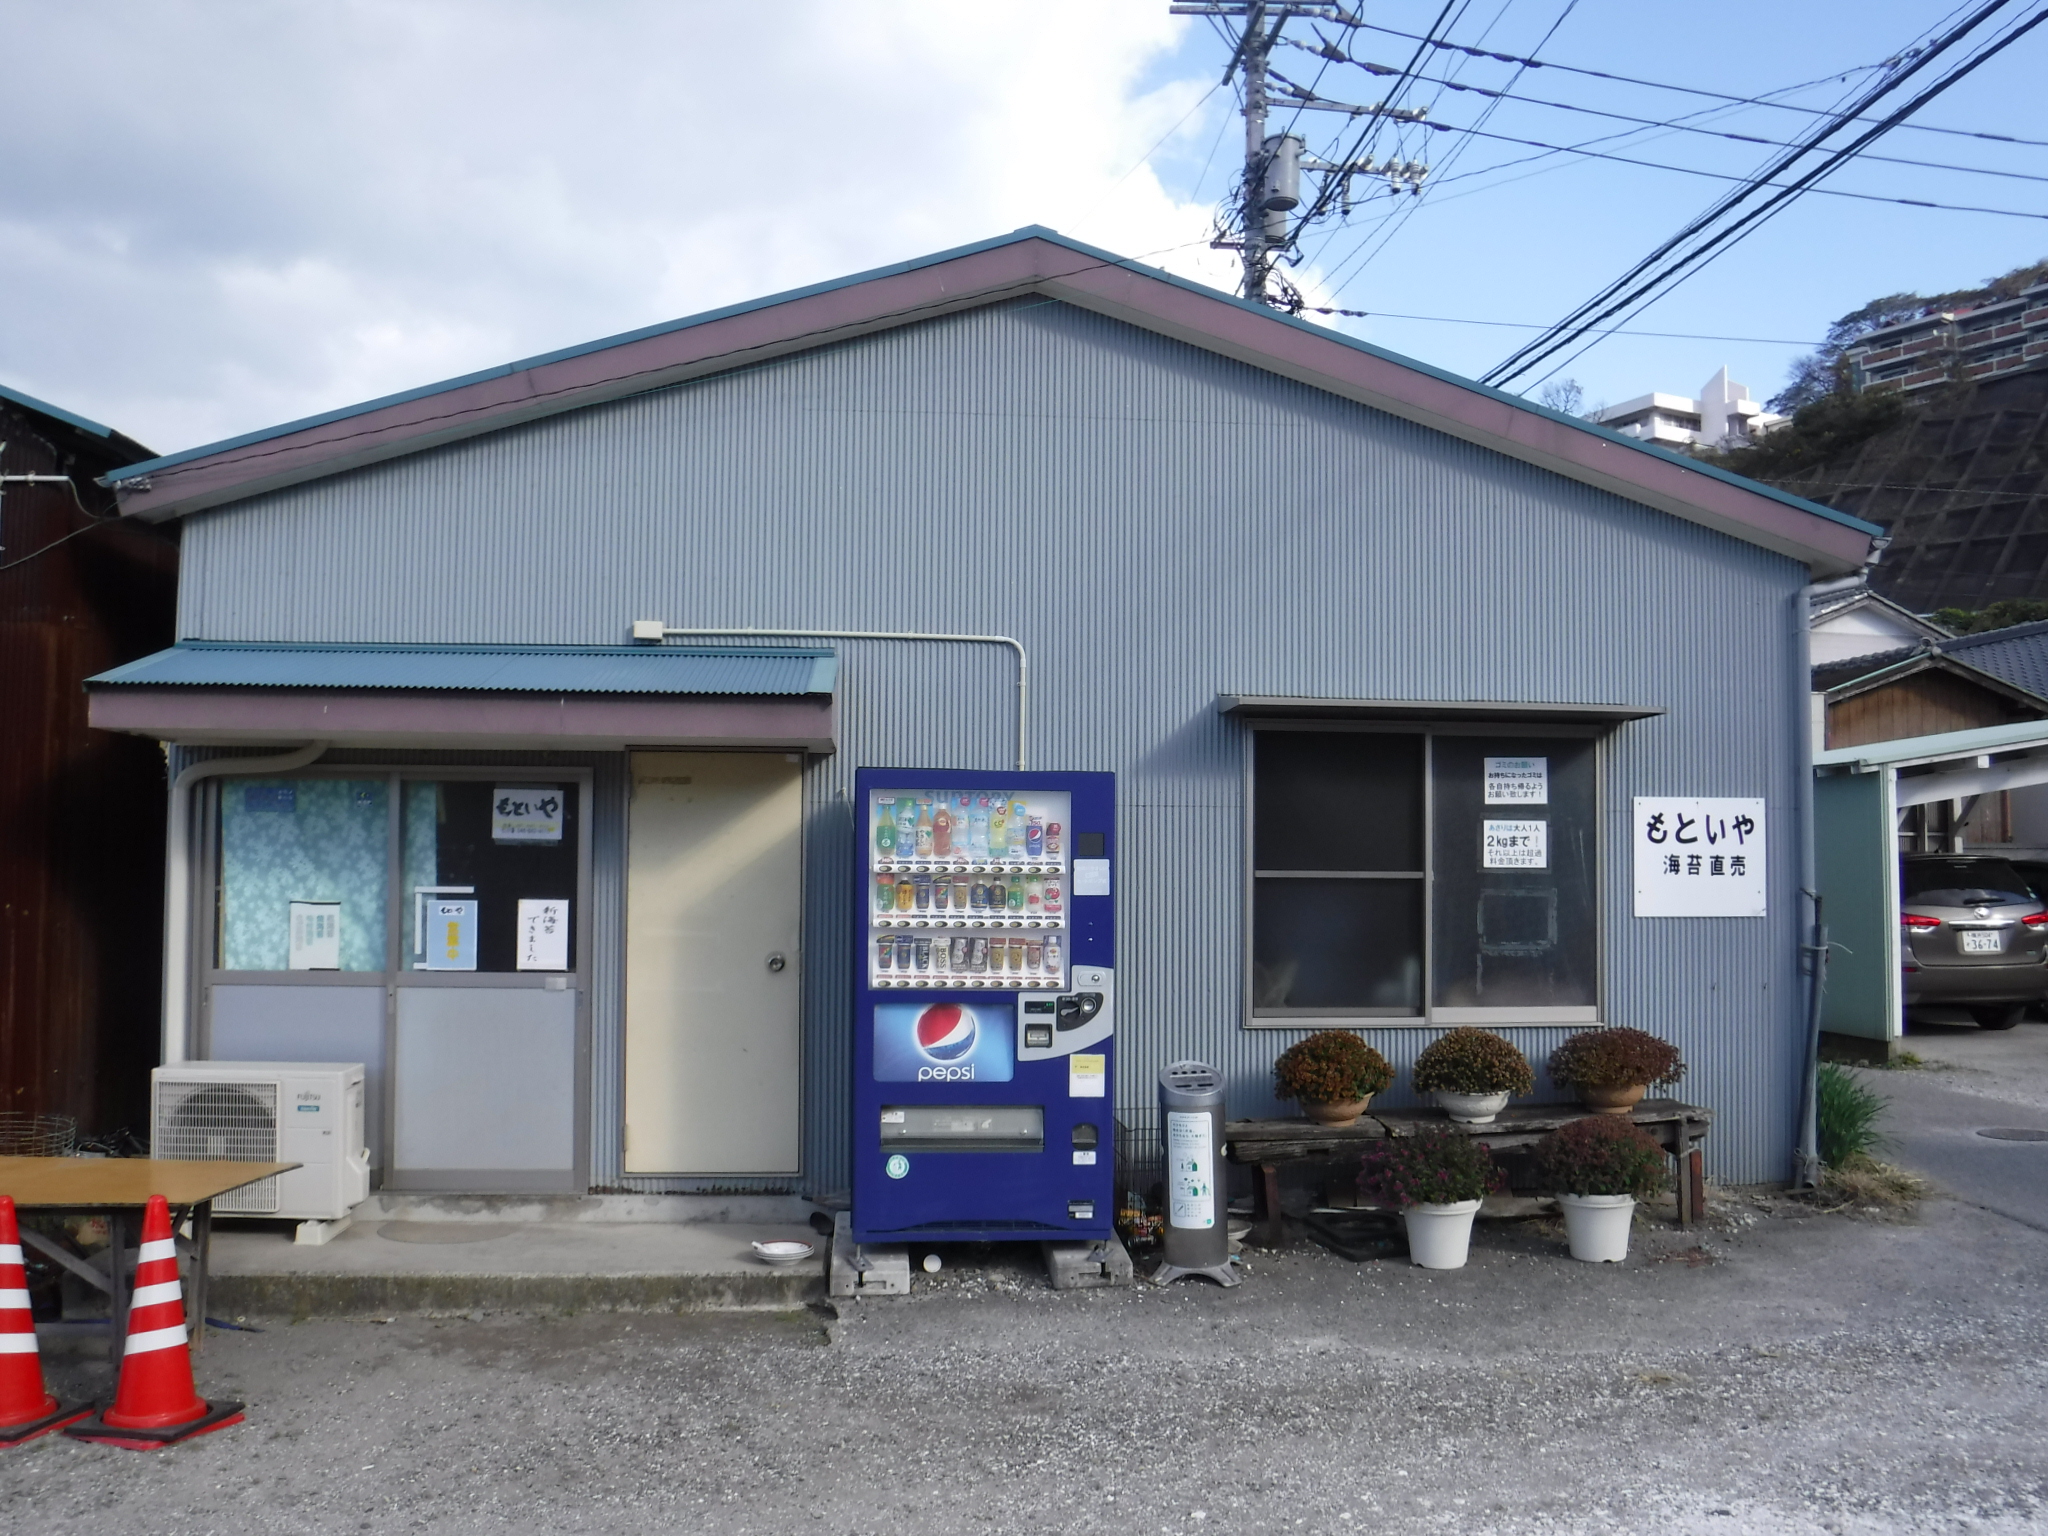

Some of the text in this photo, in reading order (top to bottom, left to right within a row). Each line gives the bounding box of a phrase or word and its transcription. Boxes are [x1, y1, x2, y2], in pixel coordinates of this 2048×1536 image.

[1495, 761, 1535, 769] ゴミのお願い
[1488, 782, 1543, 790] 各自持ち帰るよう
[1488, 824, 1541, 832] あさりは大人1人
[1646, 811, 1755, 846] もといや
[1488, 849, 1542, 857] それ以上は超過
[1663, 854, 1746, 877] 海苔直売
[1971, 939, 1998, 950] 36-74
[939, 947, 947, 969] BOSS
[917, 1063, 975, 1082] pepsi
